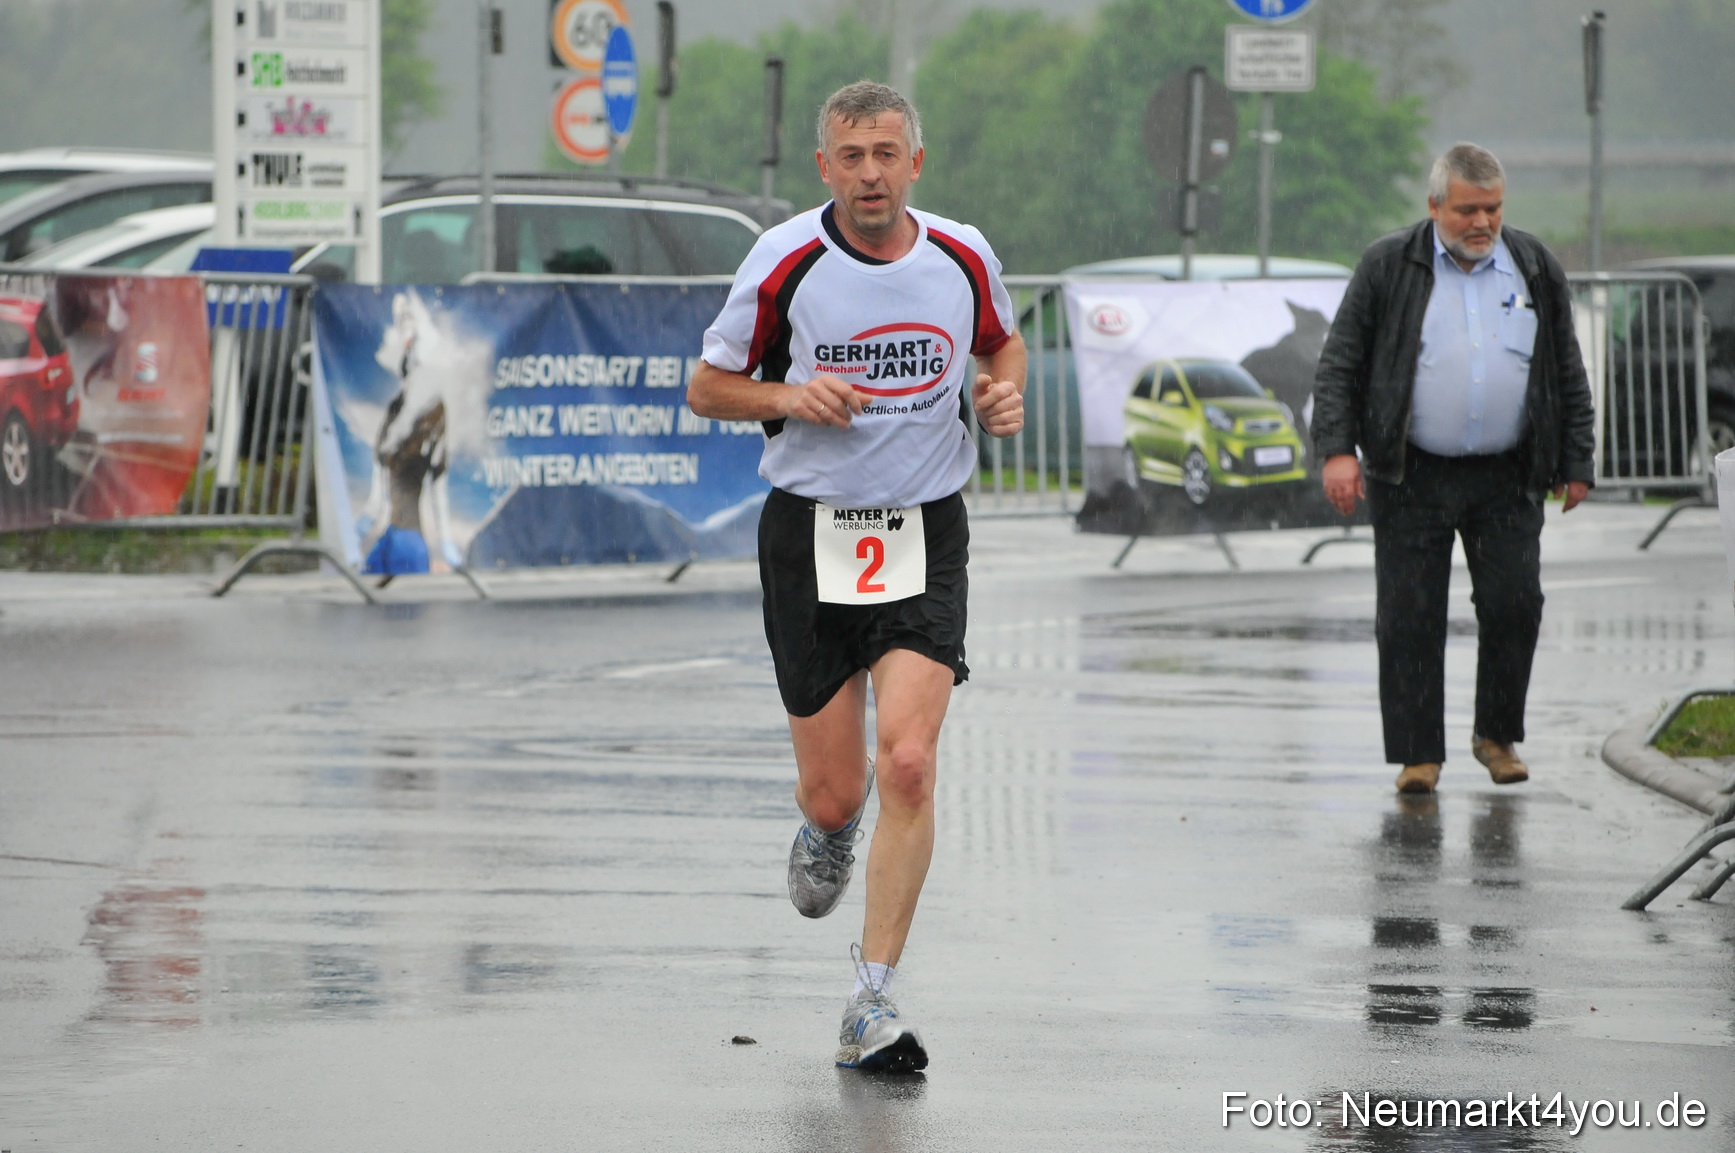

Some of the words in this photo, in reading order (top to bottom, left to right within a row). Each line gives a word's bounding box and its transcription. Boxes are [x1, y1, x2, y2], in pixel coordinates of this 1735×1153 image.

[570, 10, 612, 48] 60
[253, 154, 302, 186] THULE
[814, 339, 931, 362] GERHART
[934, 343, 942, 353] &
[494, 354, 644, 389] SAISONSTART
[644, 356, 682, 388] BEI
[814, 363, 867, 374] Autohaus
[866, 357, 944, 380] JÄNIG
[486, 405, 554, 438] GANZ
[483, 453, 699, 487] WINTERANGEBOTEN
[833, 509, 883, 521] MEYER
[833, 521, 884, 531] WERBUNG
[856, 536, 885, 593] 2
